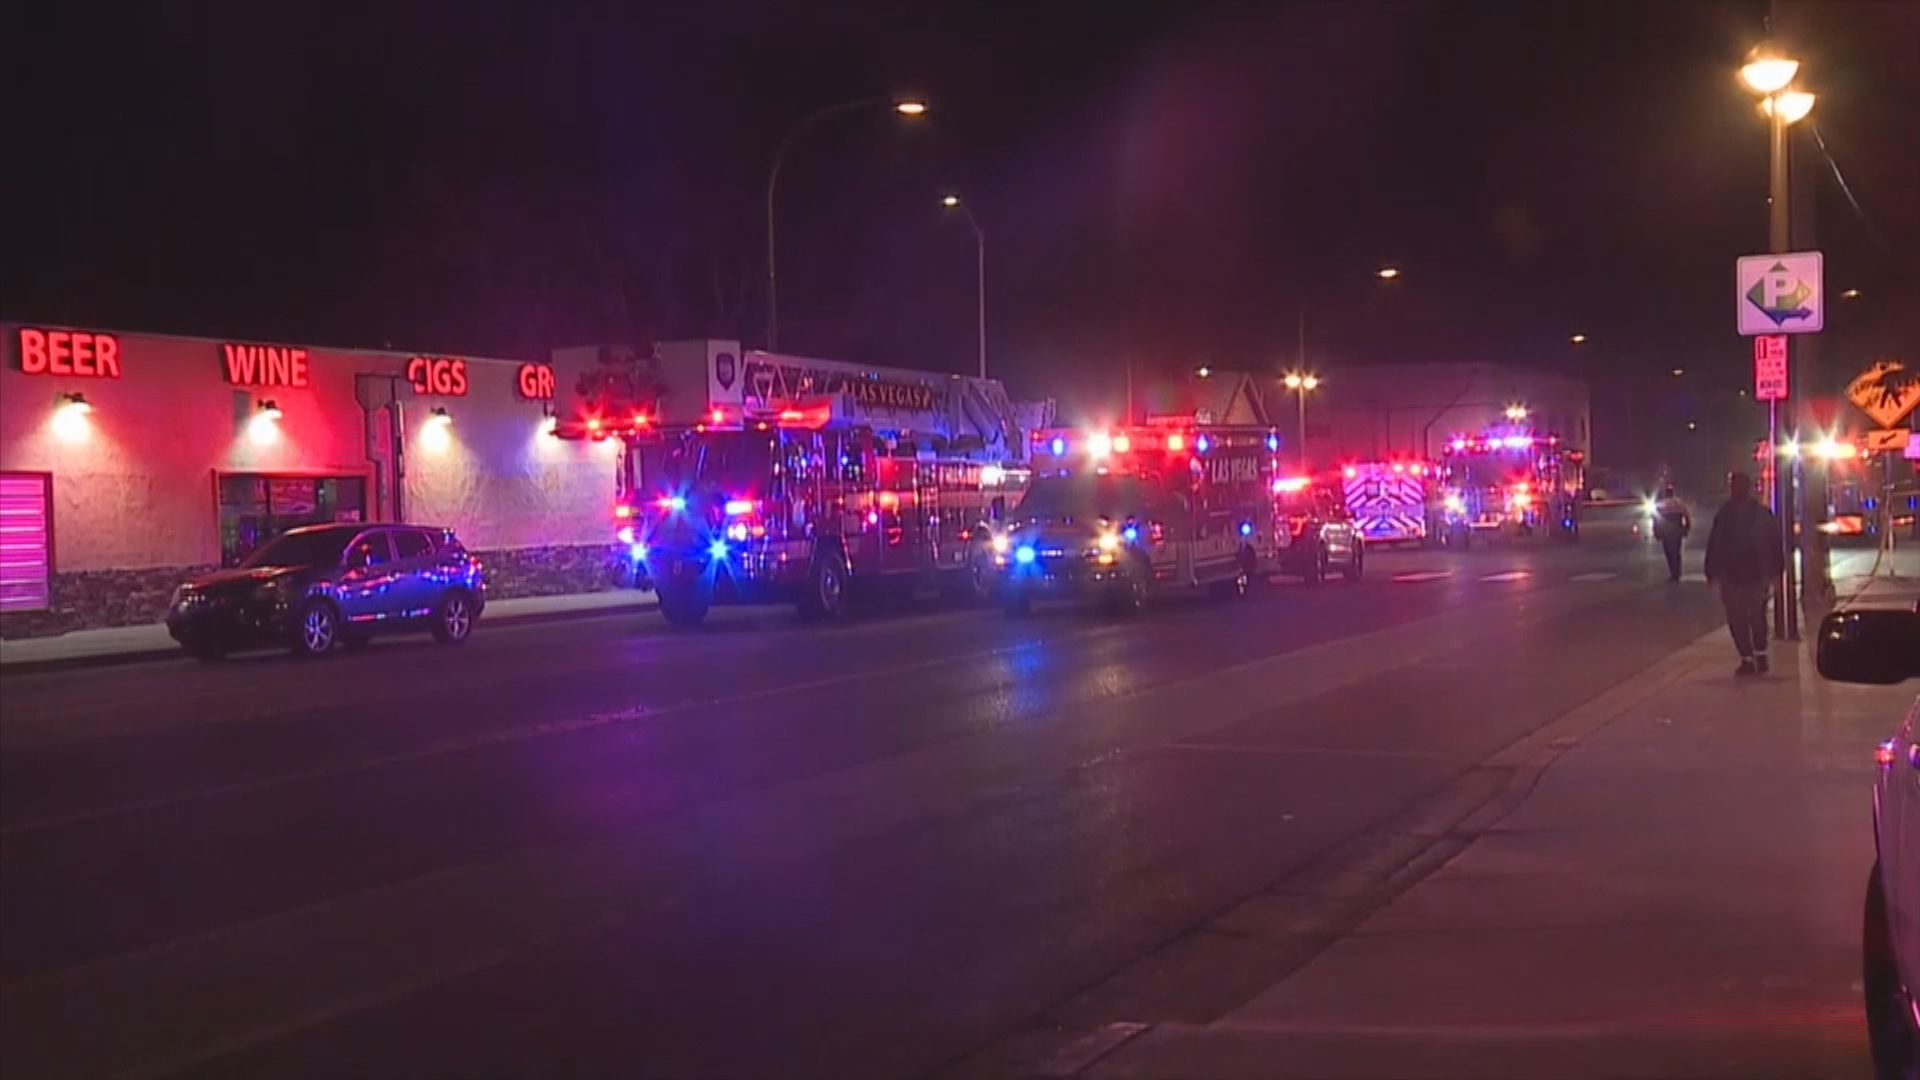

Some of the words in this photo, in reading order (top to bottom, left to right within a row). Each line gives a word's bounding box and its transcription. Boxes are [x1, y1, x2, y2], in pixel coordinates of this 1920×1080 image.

[1763, 271, 1799, 308] P
[20, 329, 119, 378] BEER
[224, 343, 307, 387] WINE
[408, 357, 467, 394] CIGS
[520, 364, 554, 398] GR
[851, 380, 877, 402] LAS
[879, 384, 921, 405] VEGAS
[1212, 458, 1229, 483] LAS
[1230, 456, 1258, 481] VEGAS
